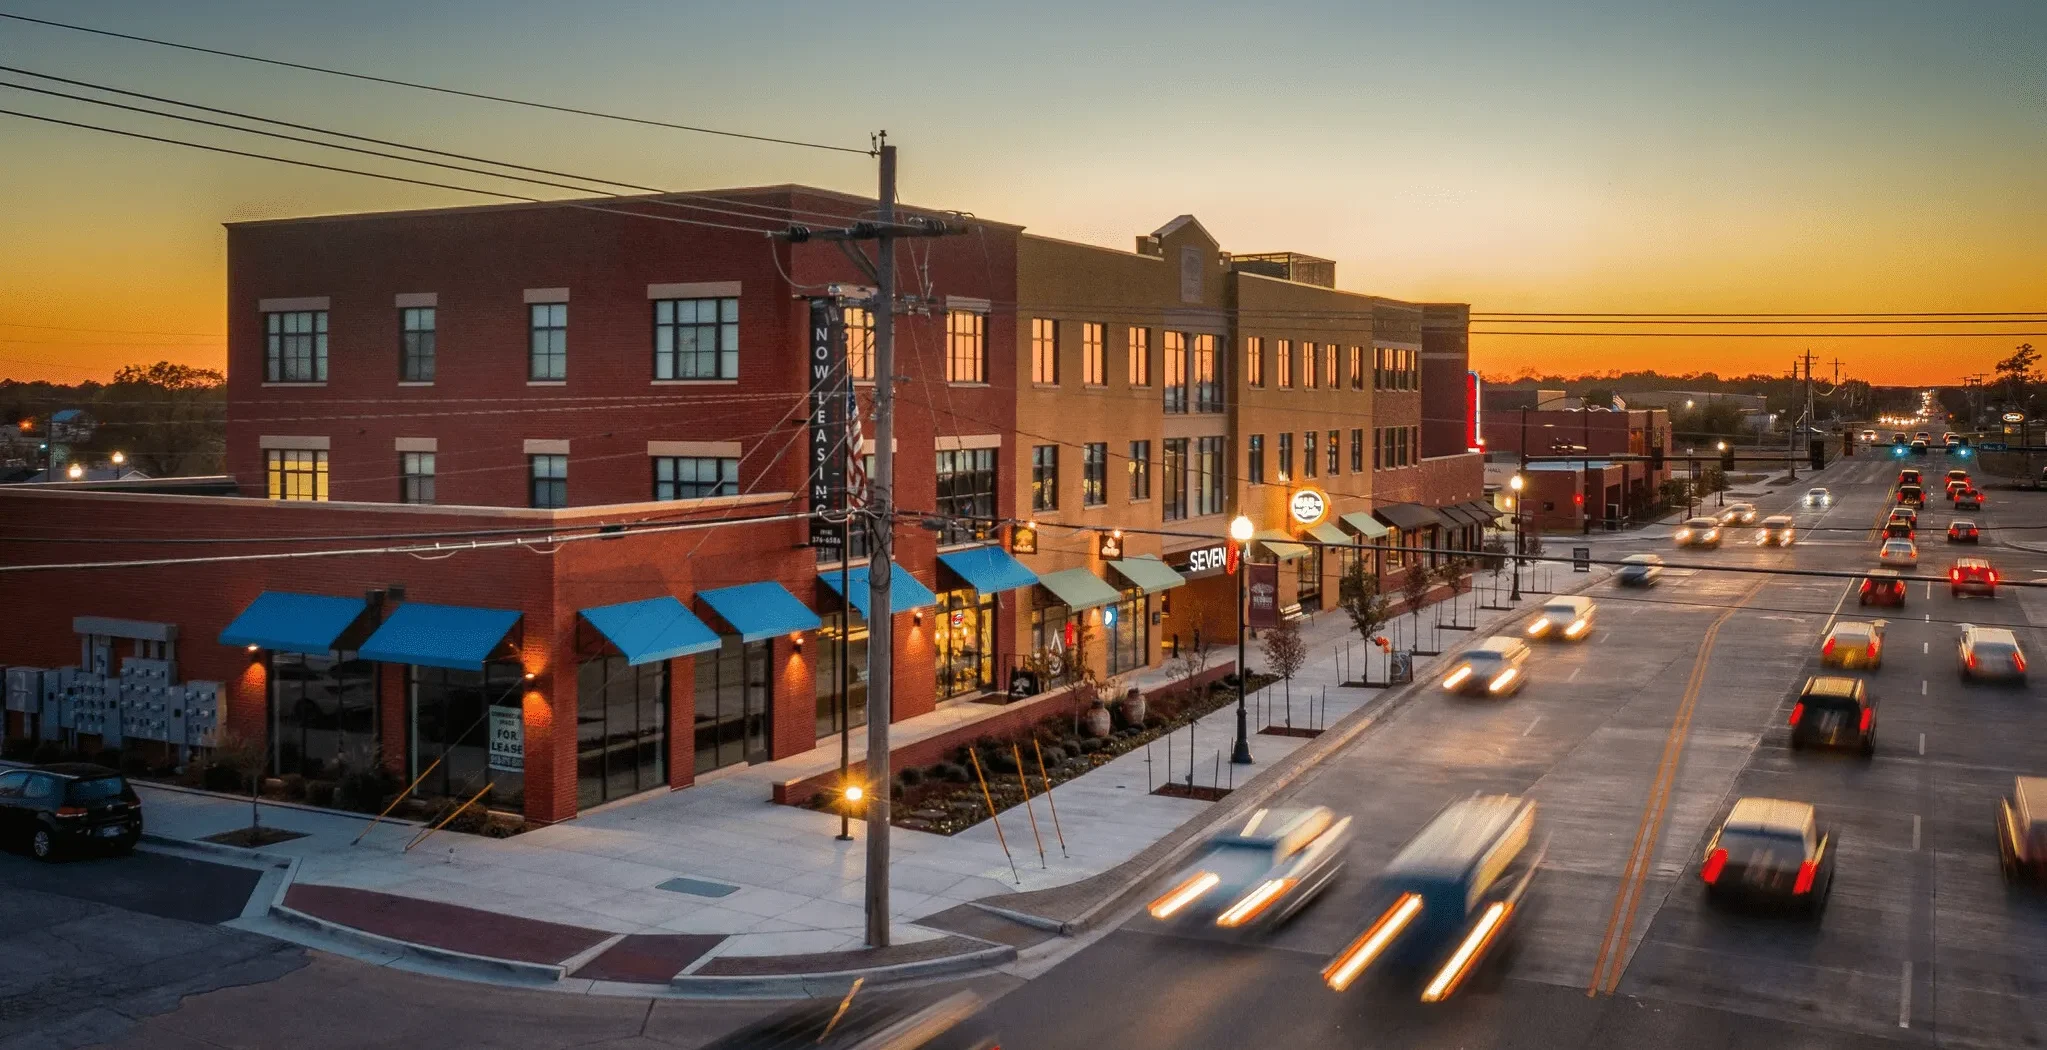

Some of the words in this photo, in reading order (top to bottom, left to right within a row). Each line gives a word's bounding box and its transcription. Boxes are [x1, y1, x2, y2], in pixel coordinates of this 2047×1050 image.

[814, 327, 829, 379] NOW
[1189, 547, 1227, 572] SEVEN
[497, 729, 519, 741] FOR
[491, 741, 523, 754] LEASE
